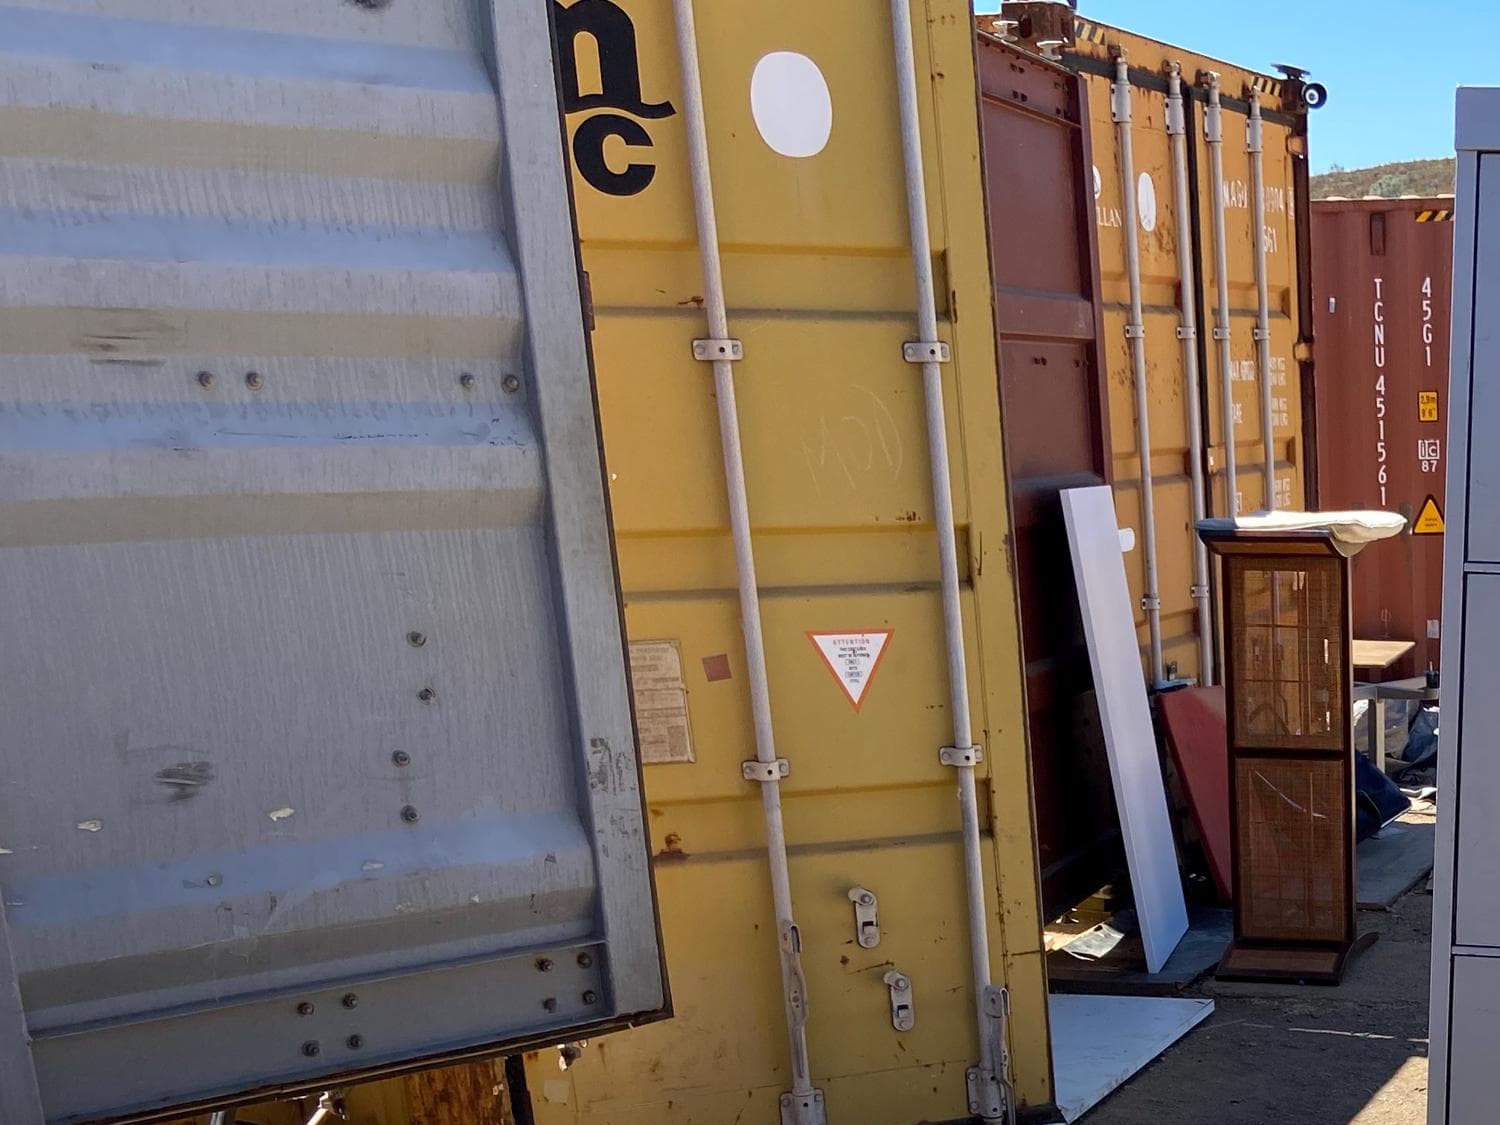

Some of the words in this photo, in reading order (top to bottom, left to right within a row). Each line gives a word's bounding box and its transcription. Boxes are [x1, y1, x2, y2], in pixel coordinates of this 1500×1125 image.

[1374, 278, 1385, 367] TCNU
[1422, 277, 1432, 367] 45G1
[1375, 375, 1387, 506] 451561
[1421, 460, 1437, 472] 87
